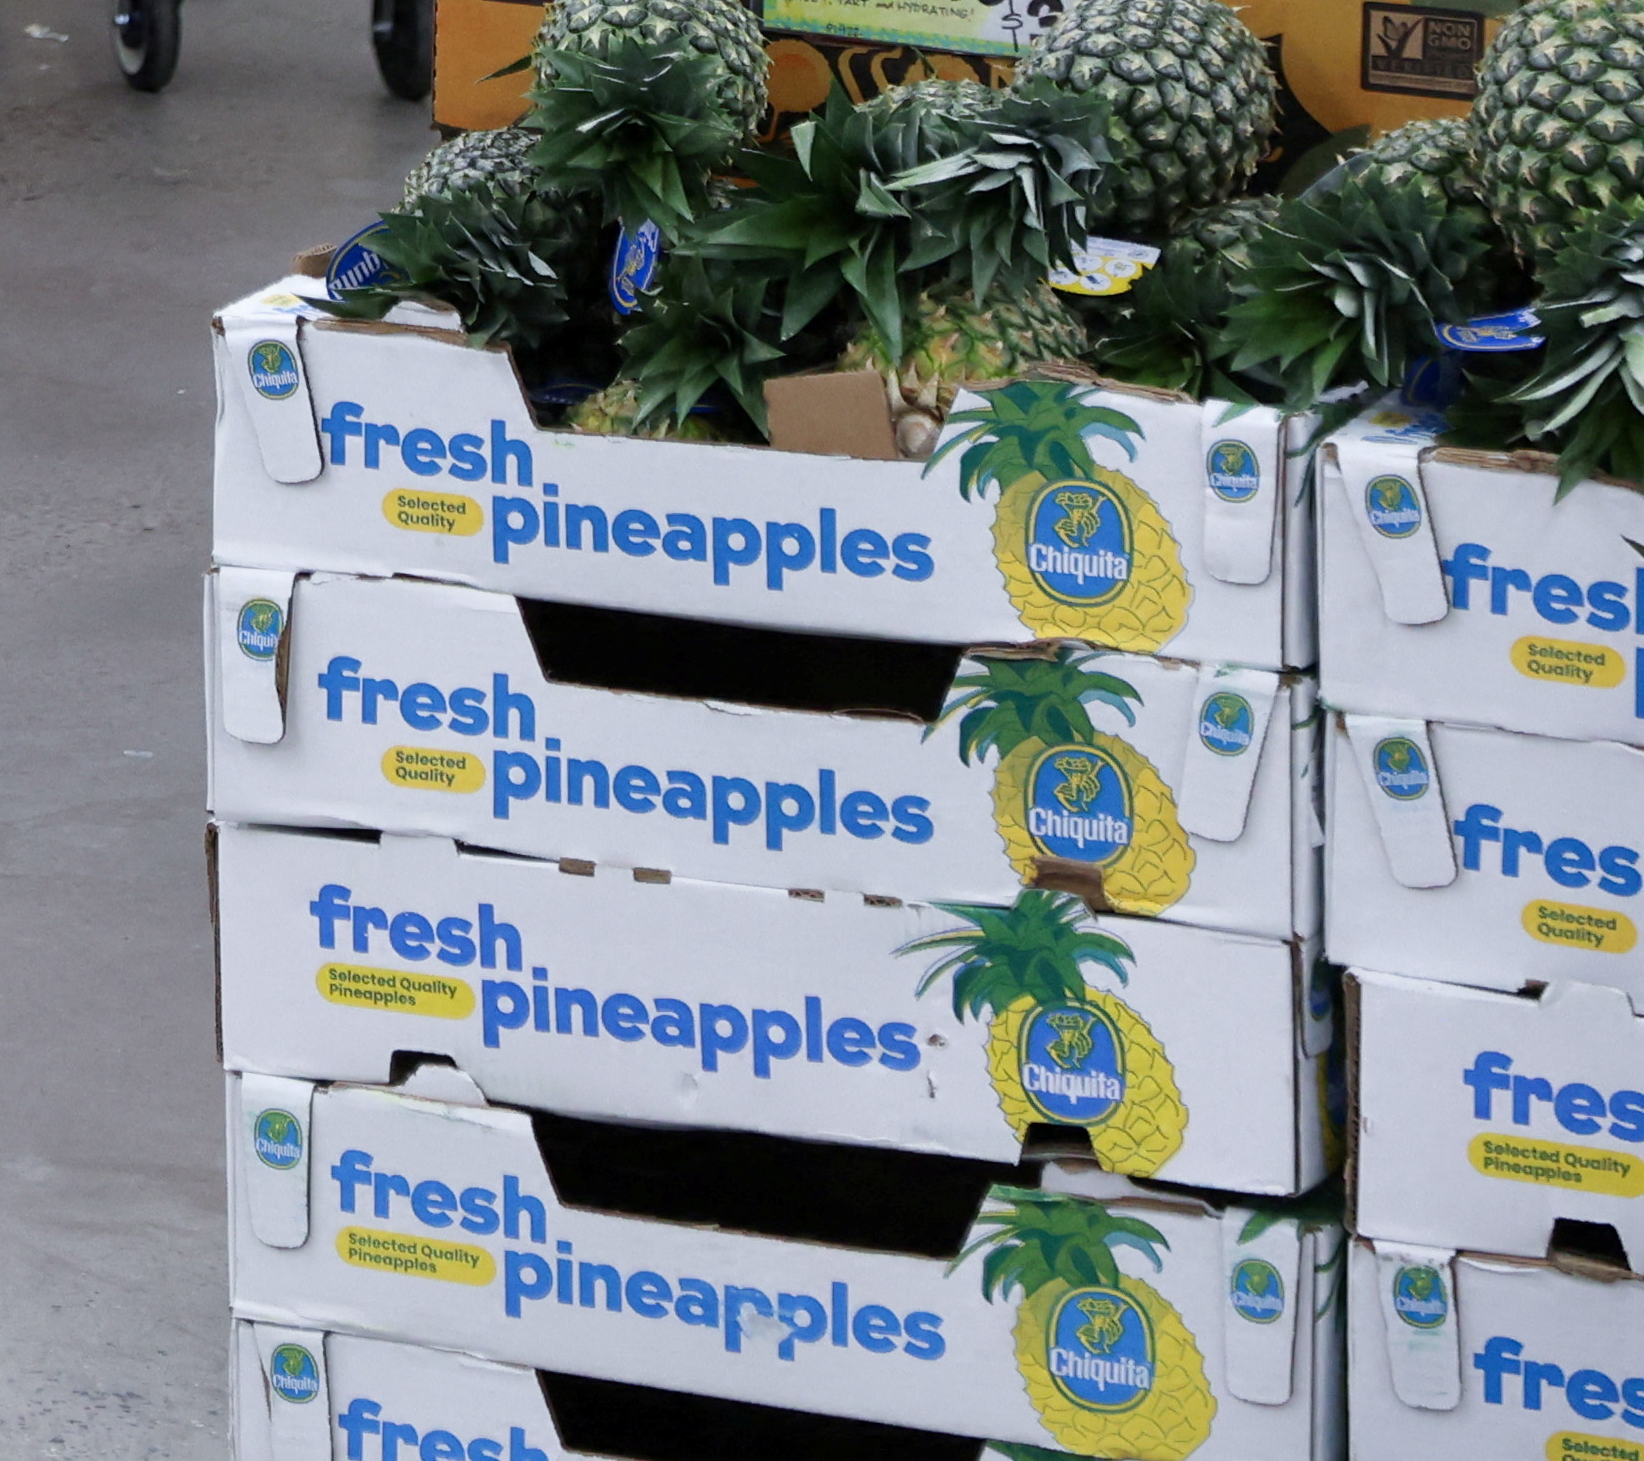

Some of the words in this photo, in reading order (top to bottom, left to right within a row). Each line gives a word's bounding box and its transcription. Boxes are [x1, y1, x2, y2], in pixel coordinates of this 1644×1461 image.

[253, 368, 300, 393] Chiquita
[322, 402, 534, 487] fresh
[396, 494, 467, 516] Selected
[396, 511, 457, 532] Quality
[492, 482, 936, 591] pineapples
[1028, 541, 1131, 584] Chiquita
[1443, 543, 1644, 635] fres
[1526, 658, 1594, 684] Quality
[1527, 642, 1607, 666] Selected
[318, 655, 537, 742] fresh
[395, 750, 468, 772] Selected
[395, 766, 457, 788] Quality
[492, 737, 936, 851] pineapples
[1028, 807, 1130, 850] Chiquita
[1453, 804, 1644, 898] fres
[309, 883, 524, 972] fresh
[1536, 905, 1617, 932] Selected
[1536, 922, 1605, 949] Quality
[327, 967, 397, 990] Selected
[399, 977, 459, 1000] Quality
[328, 983, 418, 1009] Pineapples
[481, 966, 923, 1079] pineapples
[1023, 1061, 1123, 1105] Chiquita
[255, 1136, 302, 1162] Chiquita
[1482, 1140, 1561, 1165] Selected
[1564, 1152, 1631, 1178] Quality
[1482, 1156, 1583, 1185] Pineapples
[330, 1148, 547, 1244] fresh
[347, 1231, 419, 1257] Selected
[420, 1242, 481, 1268] Quality
[347, 1246, 438, 1277] Pineapples
[503, 1241, 948, 1363] pineapples
[272, 1372, 319, 1394] Chiquita
[1048, 1347, 1152, 1392] Chiquita
[338, 1398, 550, 1461] fresh
